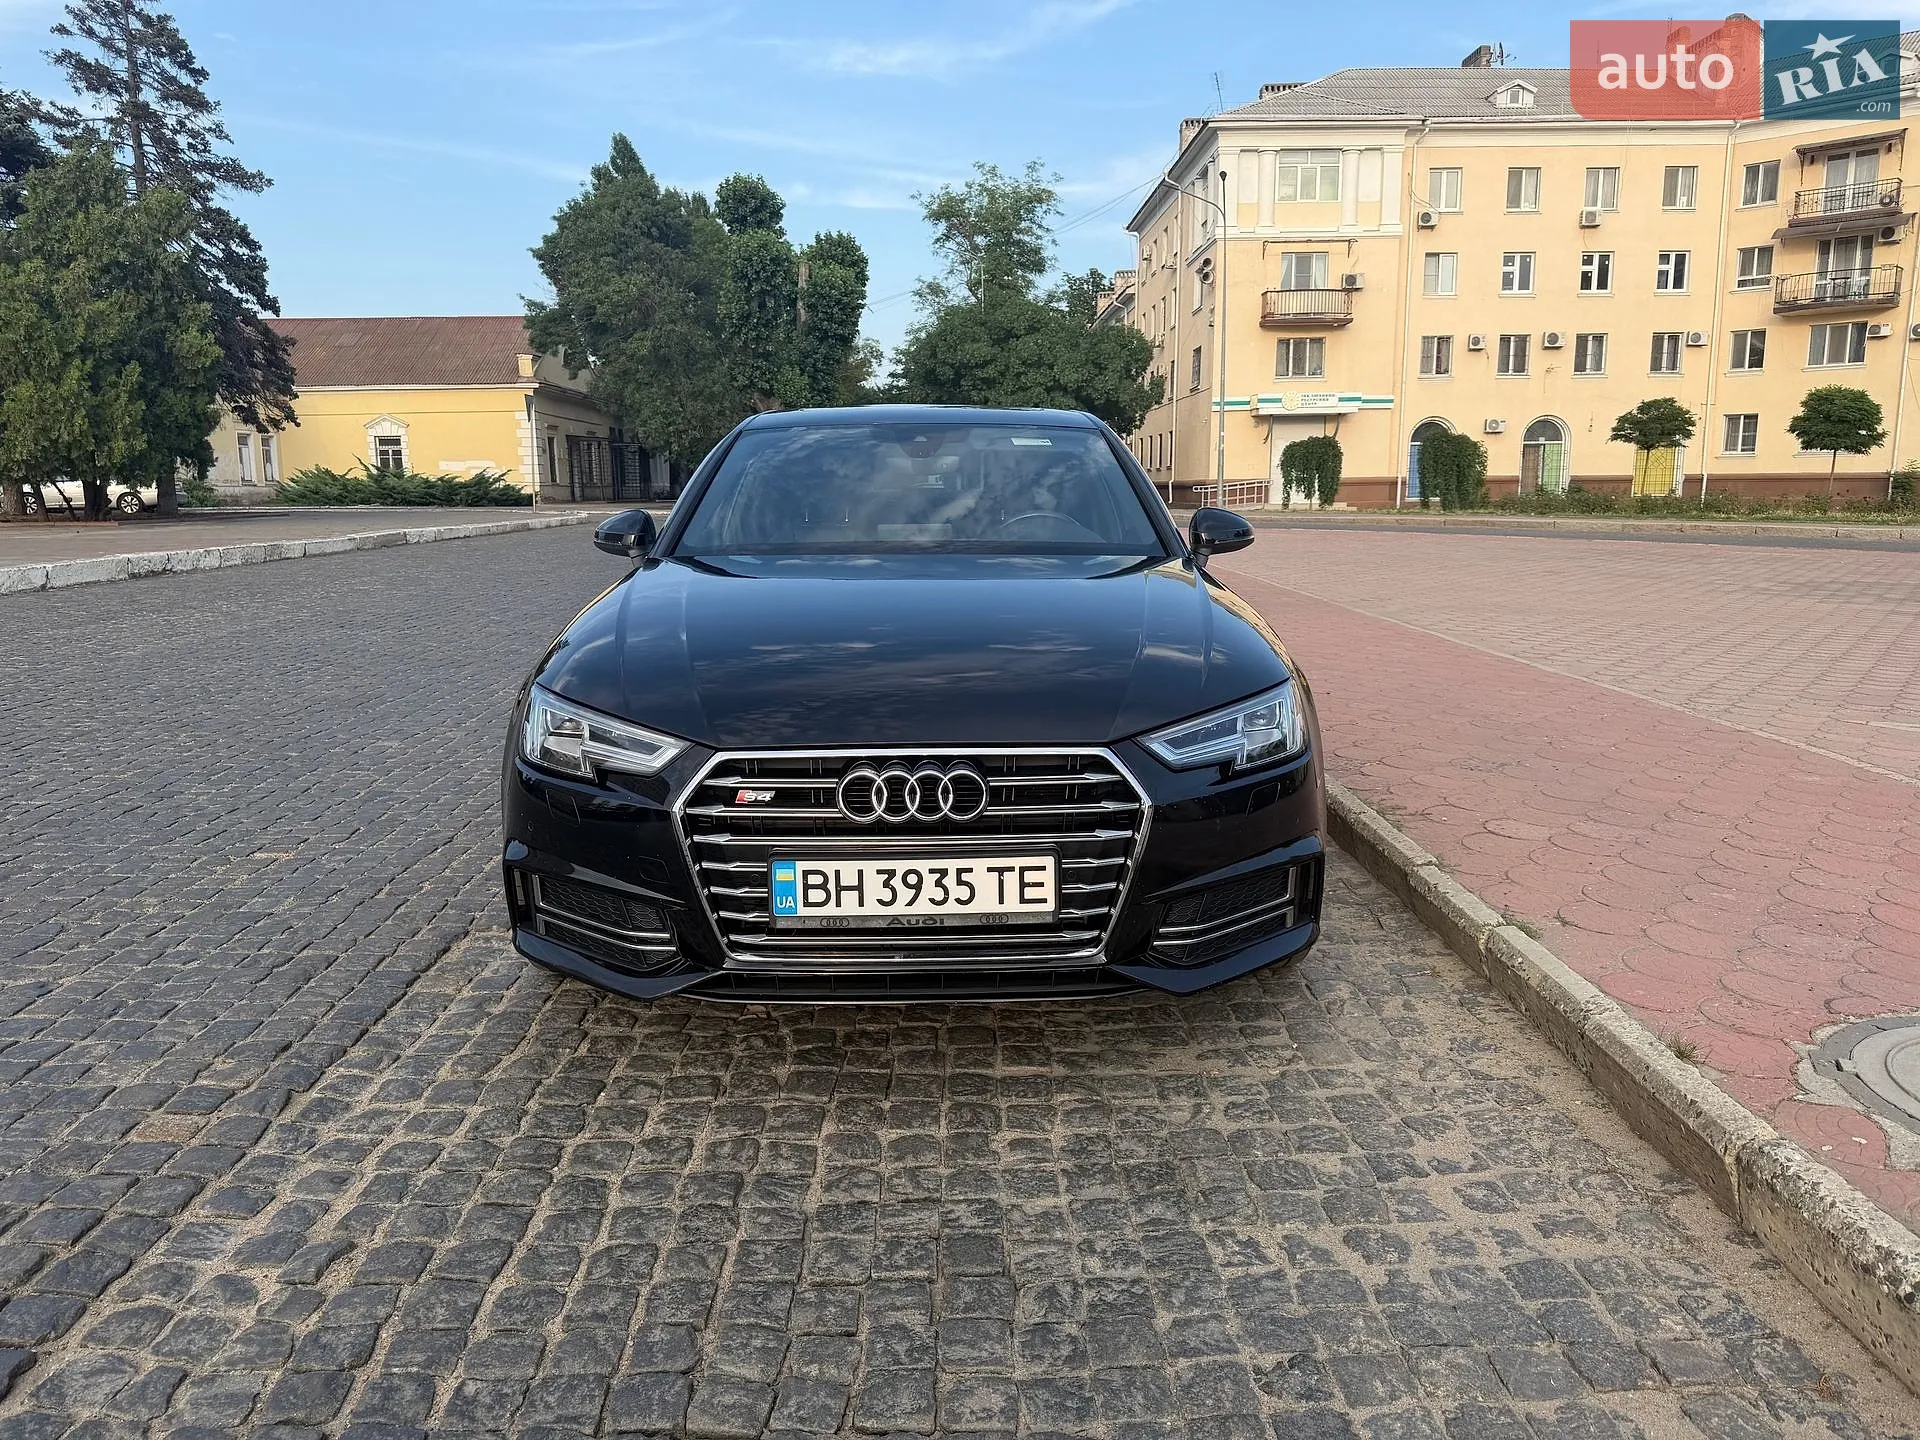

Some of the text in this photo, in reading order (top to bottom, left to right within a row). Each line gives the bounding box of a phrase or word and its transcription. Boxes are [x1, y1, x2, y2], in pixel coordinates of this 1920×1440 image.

[742, 791, 774, 802] S4
[801, 865, 1048, 908] BH 3935 TE
[776, 895, 796, 909] UA
[886, 916, 946, 927] Audi
